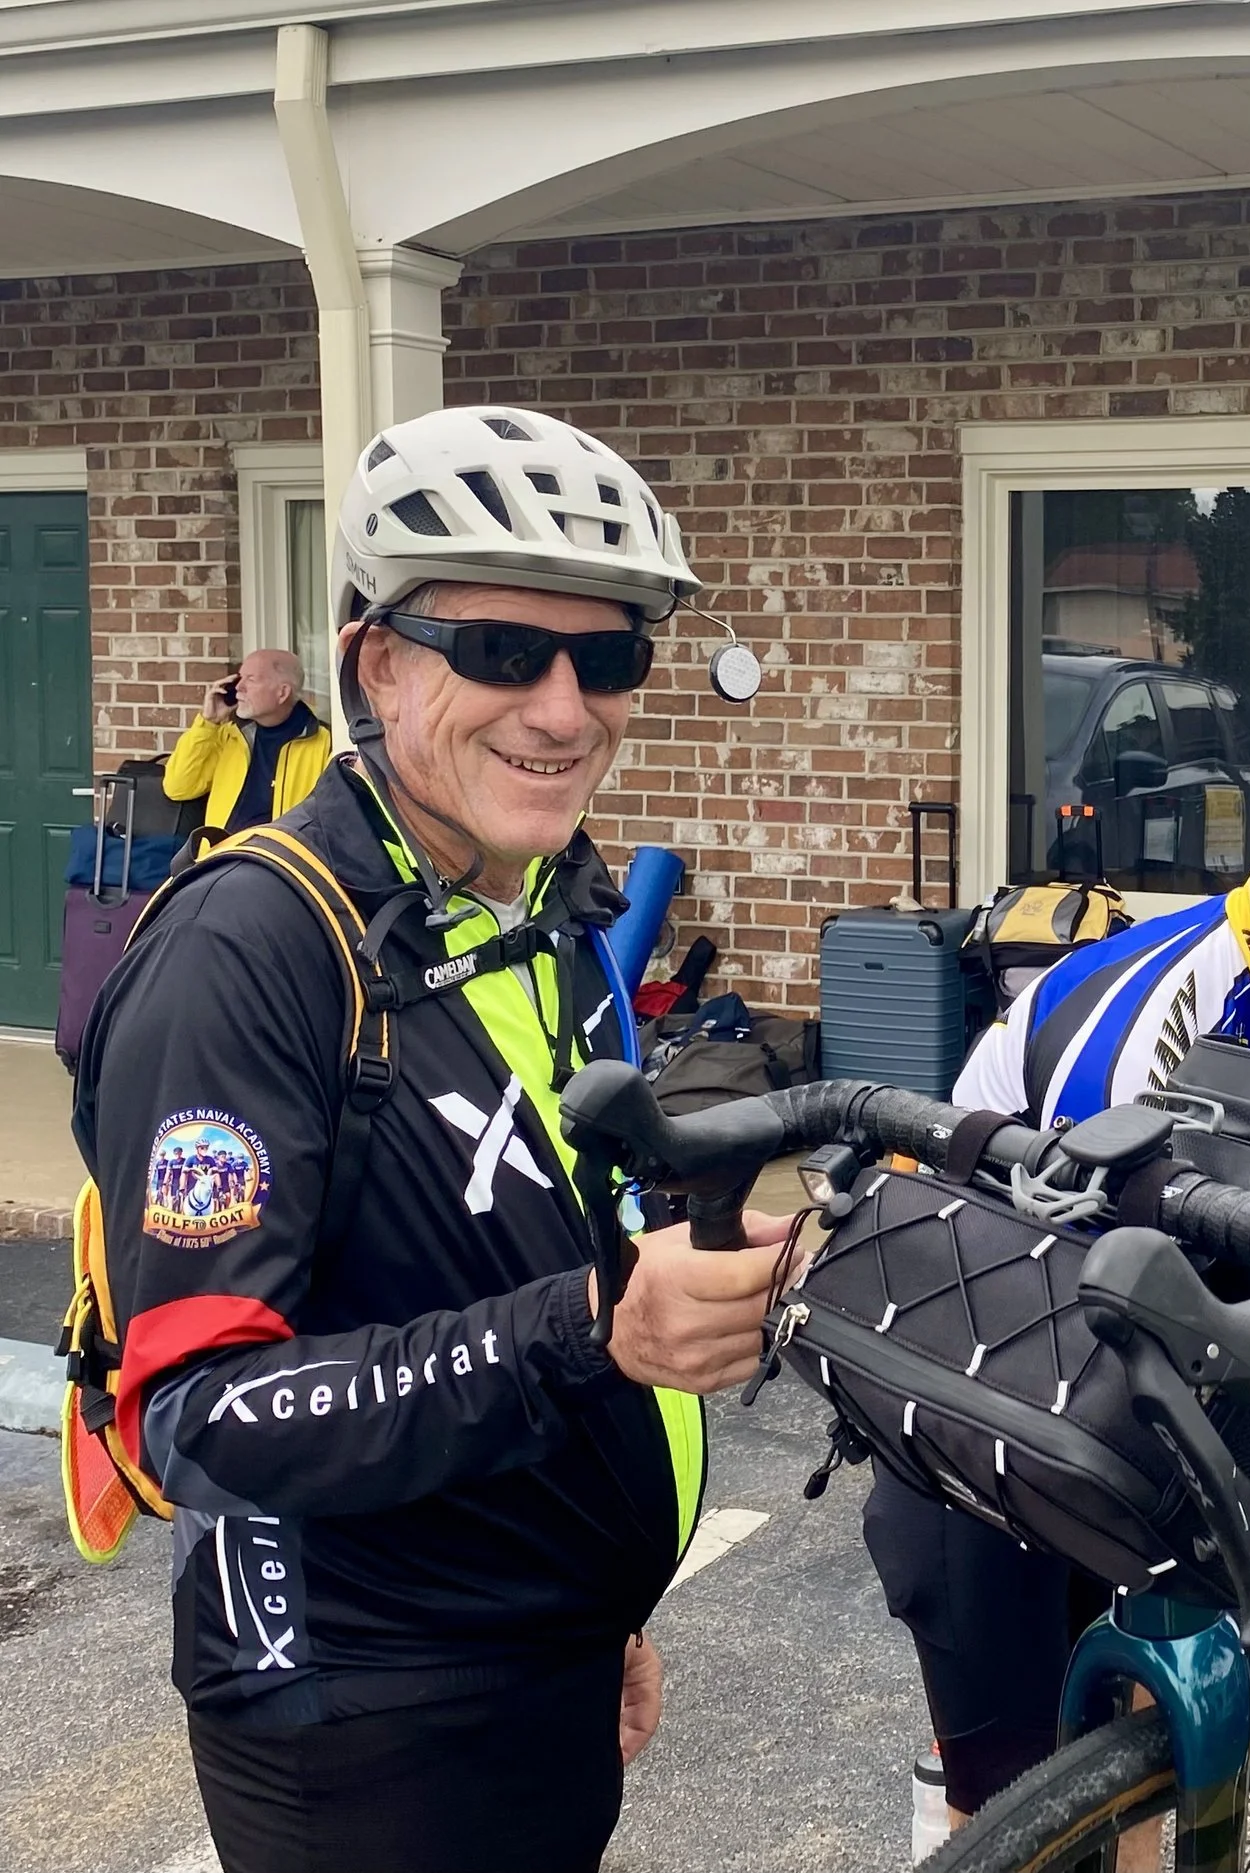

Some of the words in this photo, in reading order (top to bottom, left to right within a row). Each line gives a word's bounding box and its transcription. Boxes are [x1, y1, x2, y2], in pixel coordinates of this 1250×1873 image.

[425, 953, 477, 989] CAMELBAK
[158, 1110, 194, 1136] STATES
[196, 1109, 235, 1127] NAVAL
[235, 1123, 271, 1175] ACADEMY
[152, 1212, 191, 1230] GULF
[209, 1208, 245, 1229] GOAT
